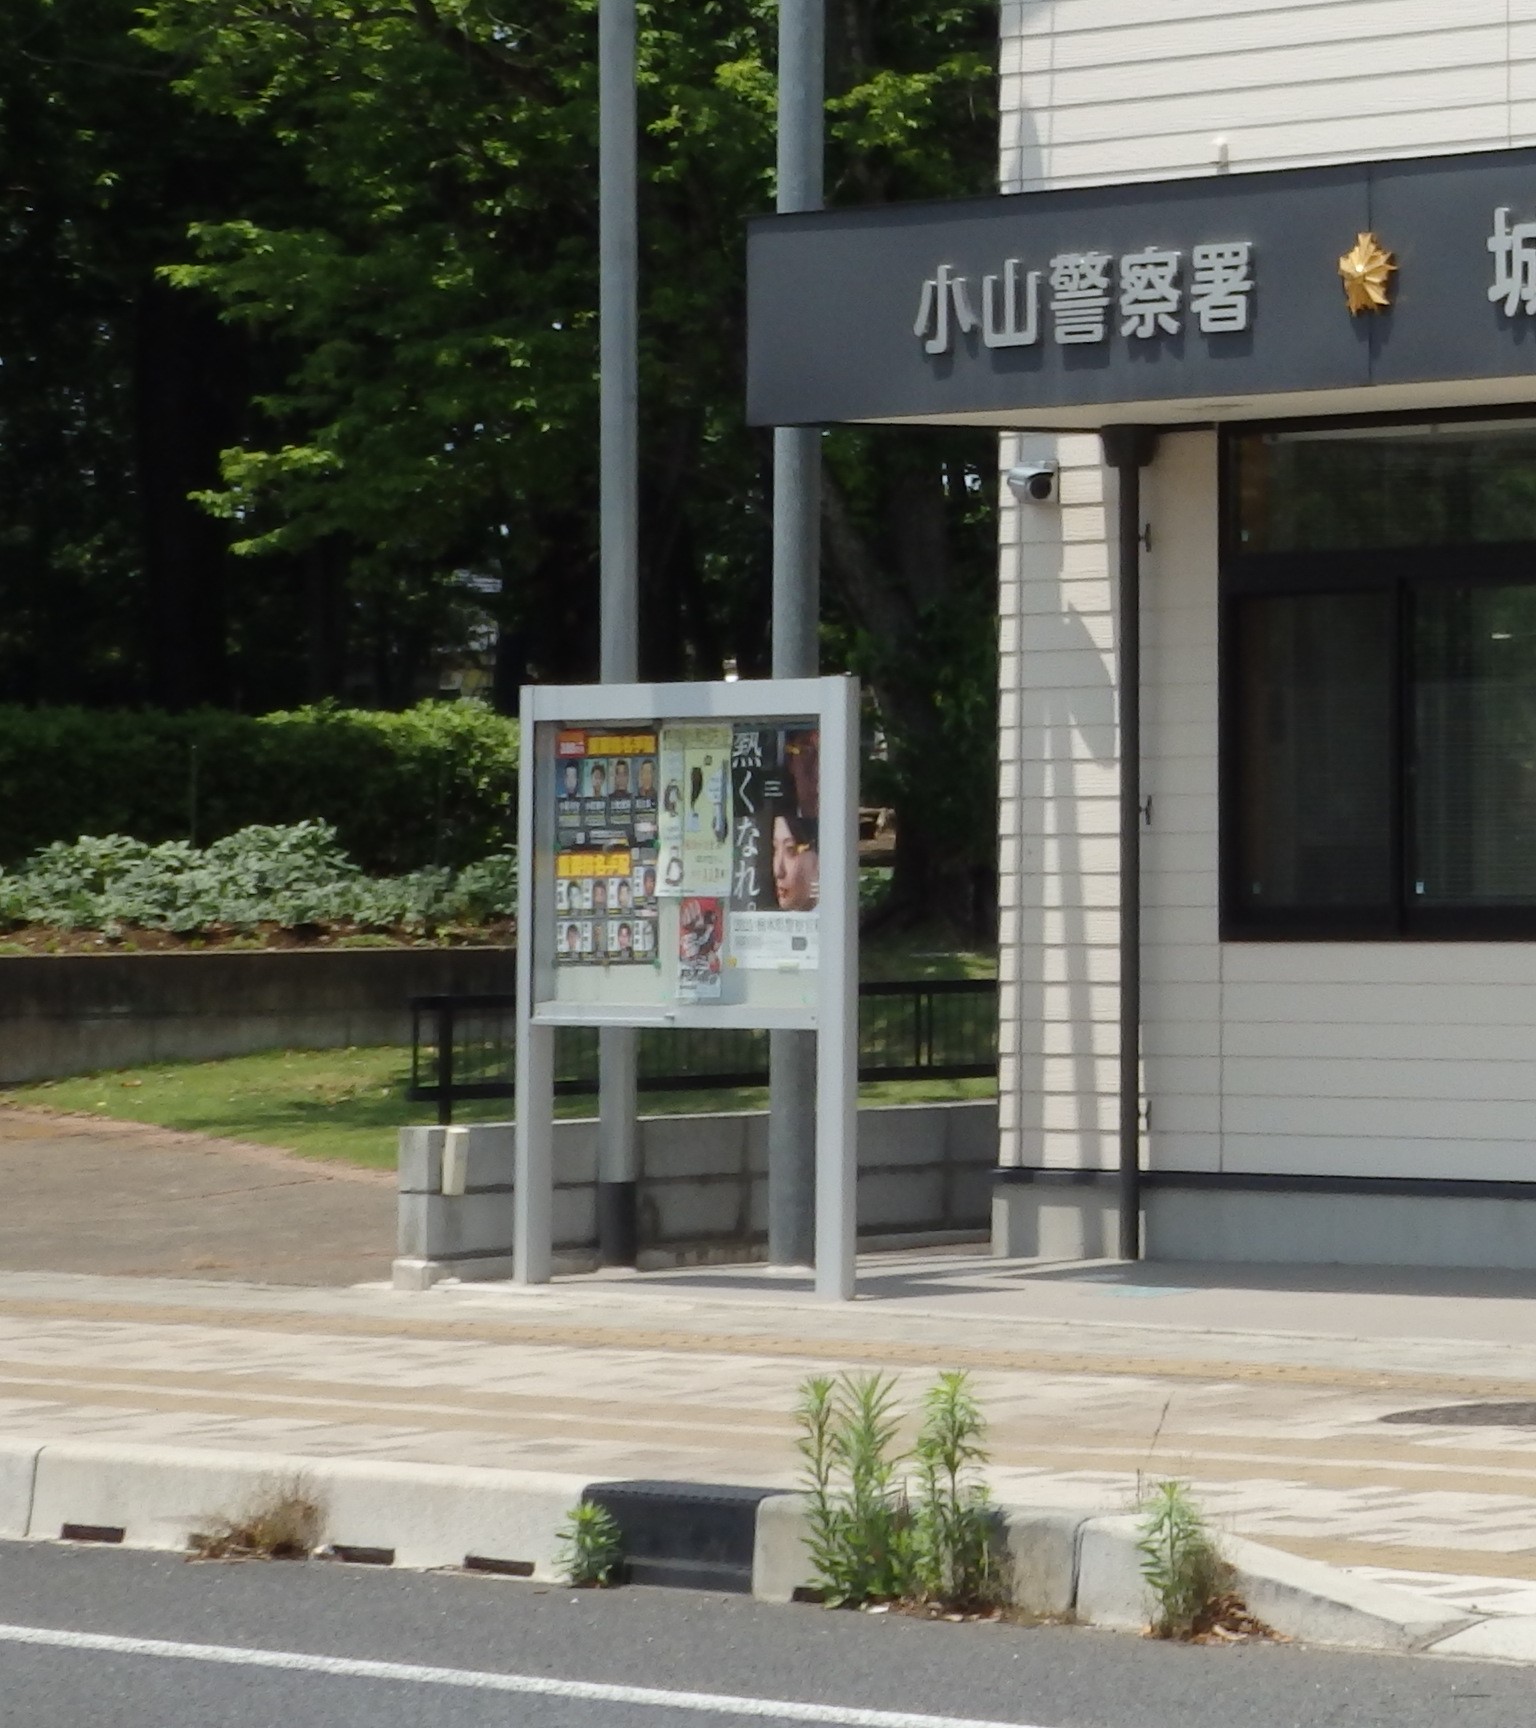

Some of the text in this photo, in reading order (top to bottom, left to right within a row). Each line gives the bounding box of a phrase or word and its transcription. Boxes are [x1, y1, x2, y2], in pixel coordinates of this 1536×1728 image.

[913, 242, 1254, 354] 小山警察署
[732, 732, 763, 911] 熱くなれ。
